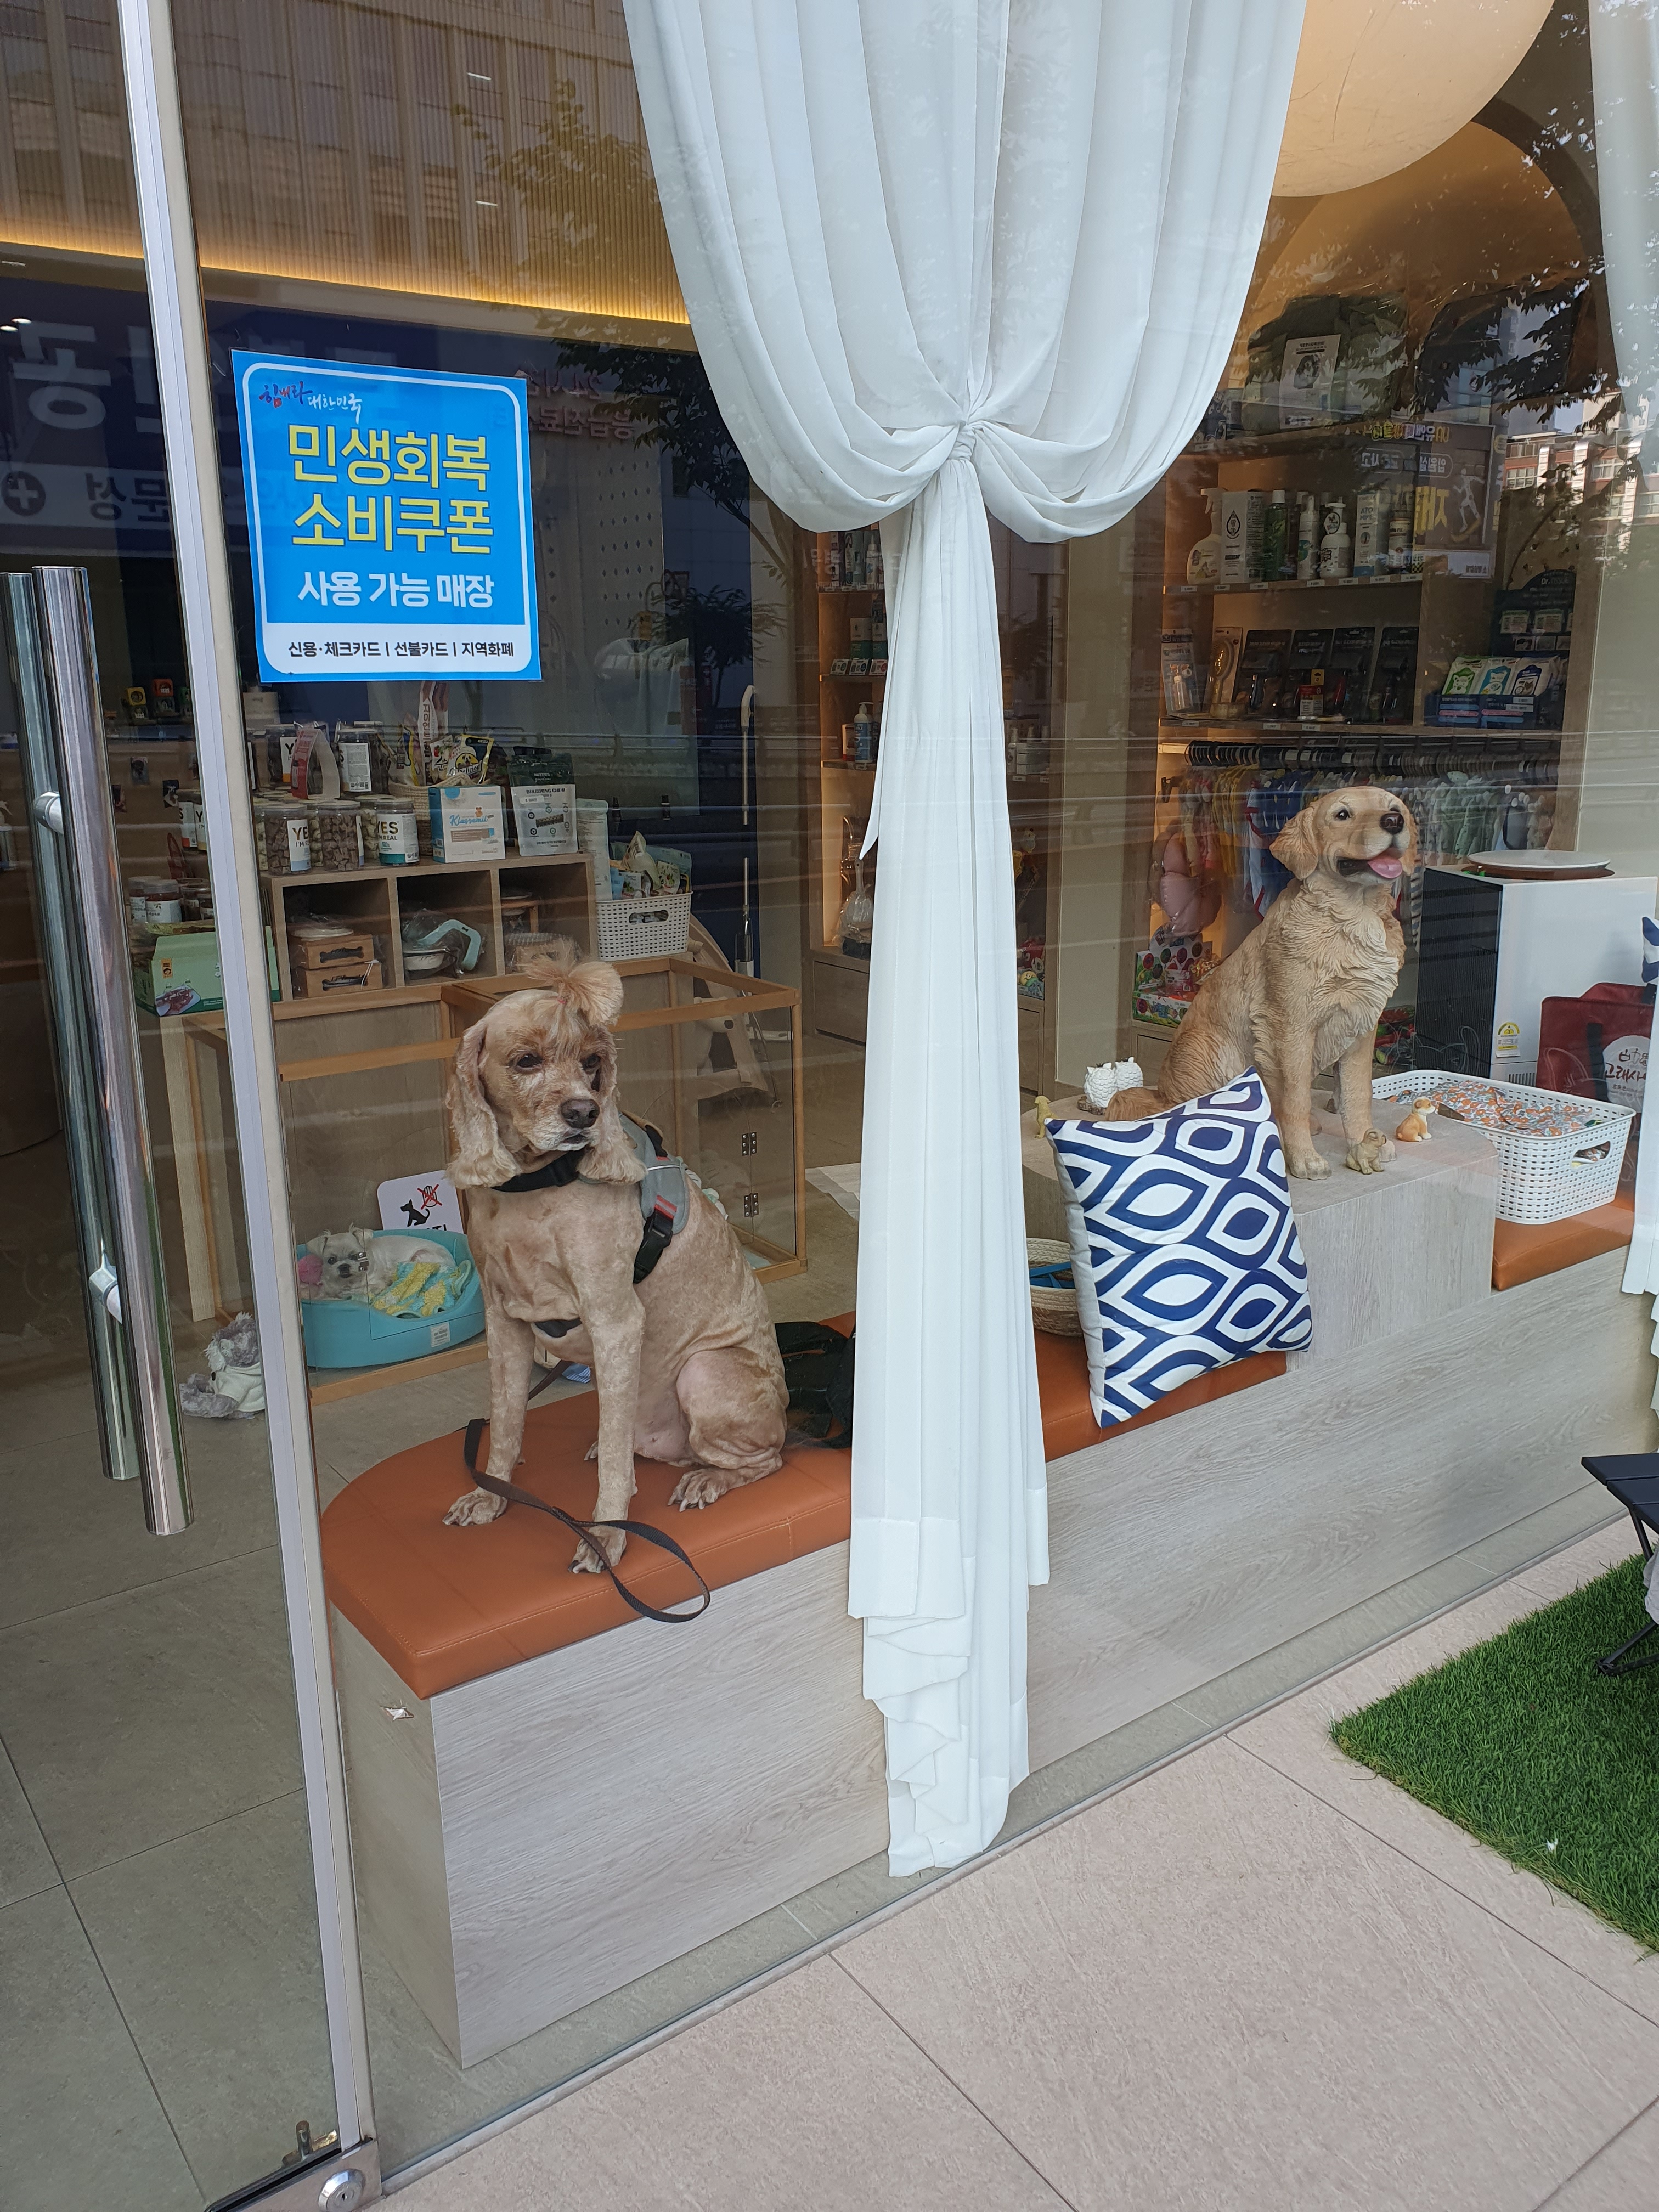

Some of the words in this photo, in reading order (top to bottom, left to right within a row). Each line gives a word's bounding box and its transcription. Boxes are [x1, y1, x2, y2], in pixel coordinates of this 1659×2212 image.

[307, 393, 363, 425] 대한민국
[288, 424, 491, 491] 민생회복
[291, 493, 493, 555] 소비쿠폰
[298, 571, 362, 606] 사용
[369, 573, 430, 607] 가능
[437, 574, 495, 608] 매장
[288, 641, 382, 657] 신용·체크카드
[394, 642, 449, 657] 선불카드
[461, 642, 515, 657] 지역화폐
